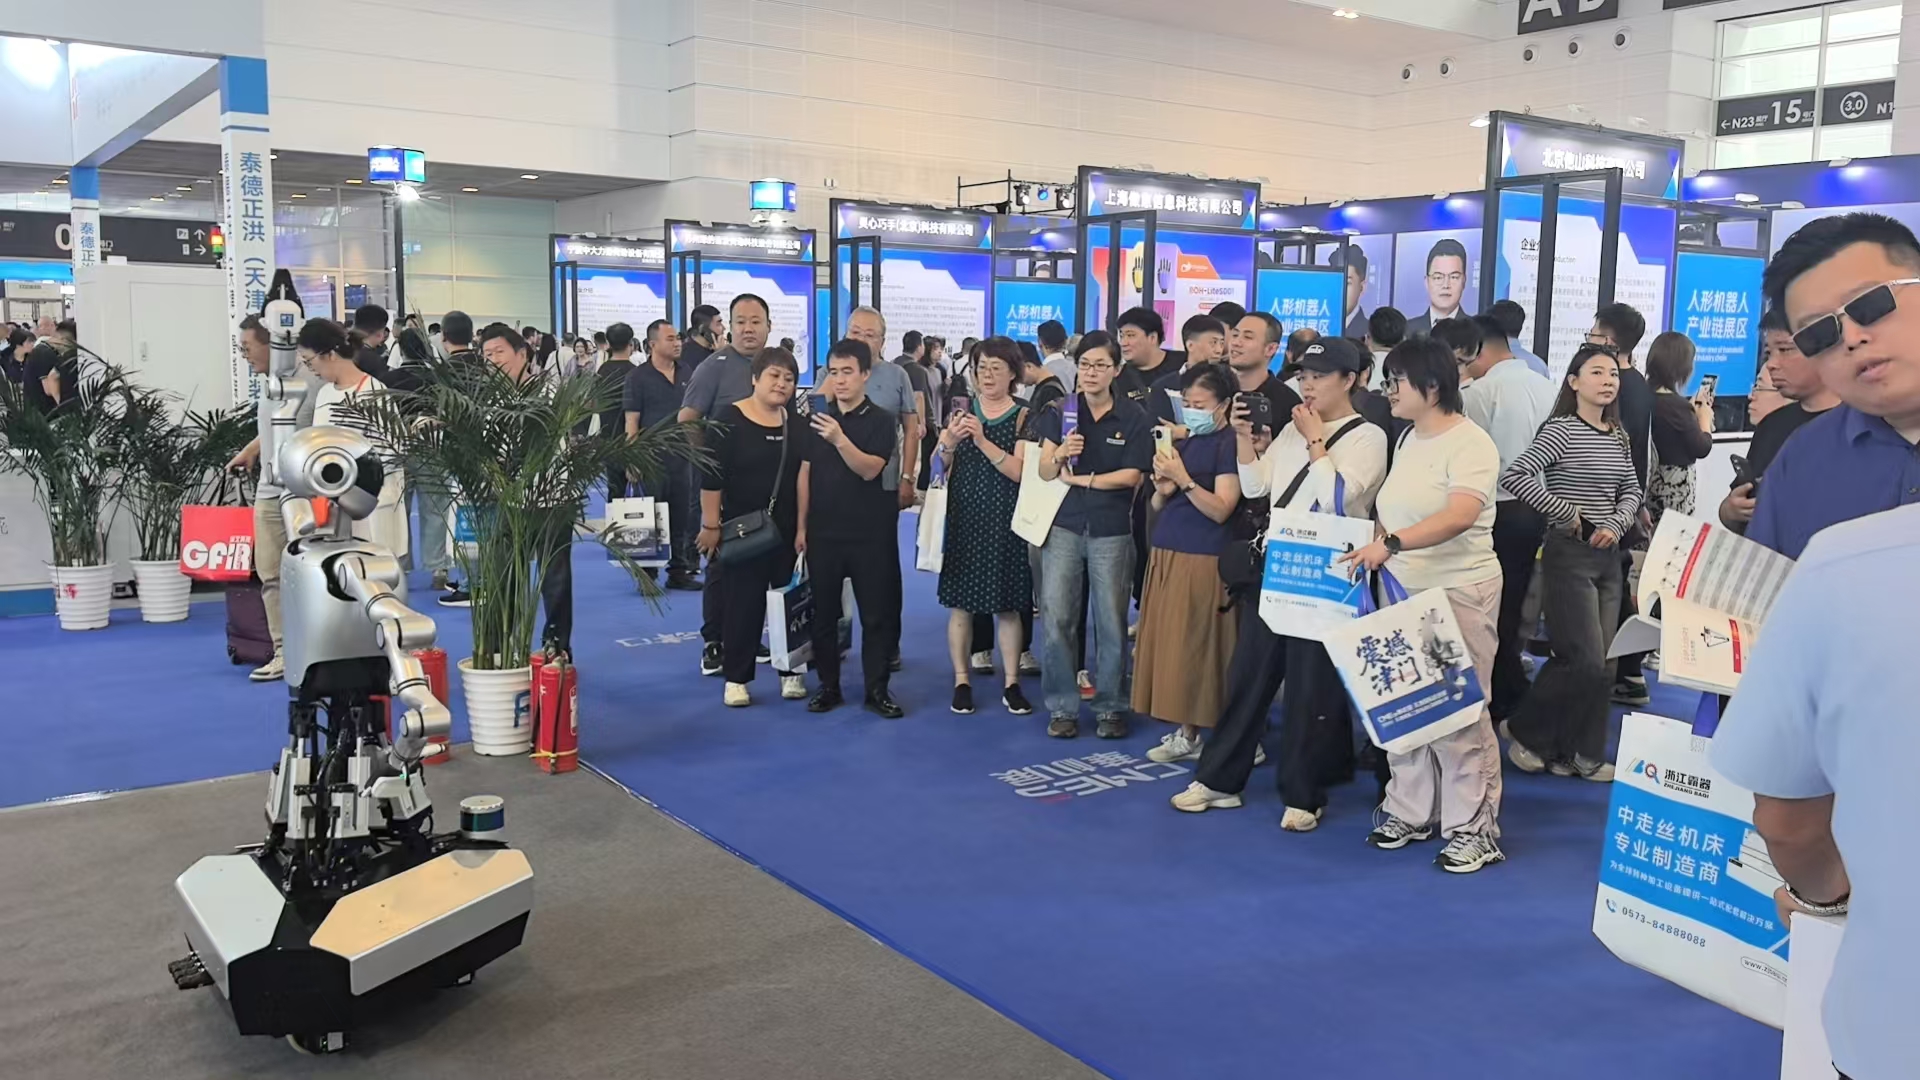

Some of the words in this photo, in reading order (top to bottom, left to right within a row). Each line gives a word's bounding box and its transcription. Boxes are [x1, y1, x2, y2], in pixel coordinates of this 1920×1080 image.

[1732, 116, 1755, 129] N23
[1771, 99, 1802, 125] 15
[1844, 100, 1864, 112] 3.0
[1006, 304, 1063, 320] 人形机器人
[1269, 297, 1330, 316] 人形机器人
[1687, 289, 1749, 313] 人形机器人
[1282, 318, 1330, 337] 业链展区
[1686, 315, 1748, 339] 产业链展区
[1271, 550, 1325, 566] 中走丝机床
[1271, 563, 1323, 580] 专业制造商
[1357, 628, 1413, 676] 震撼
[1371, 656, 1422, 696] 津门
[1617, 804, 1726, 857] 中走丝机床
[1614, 831, 1721, 886] 专业制造商
[1622, 906, 1706, 948] 0573-84888088
